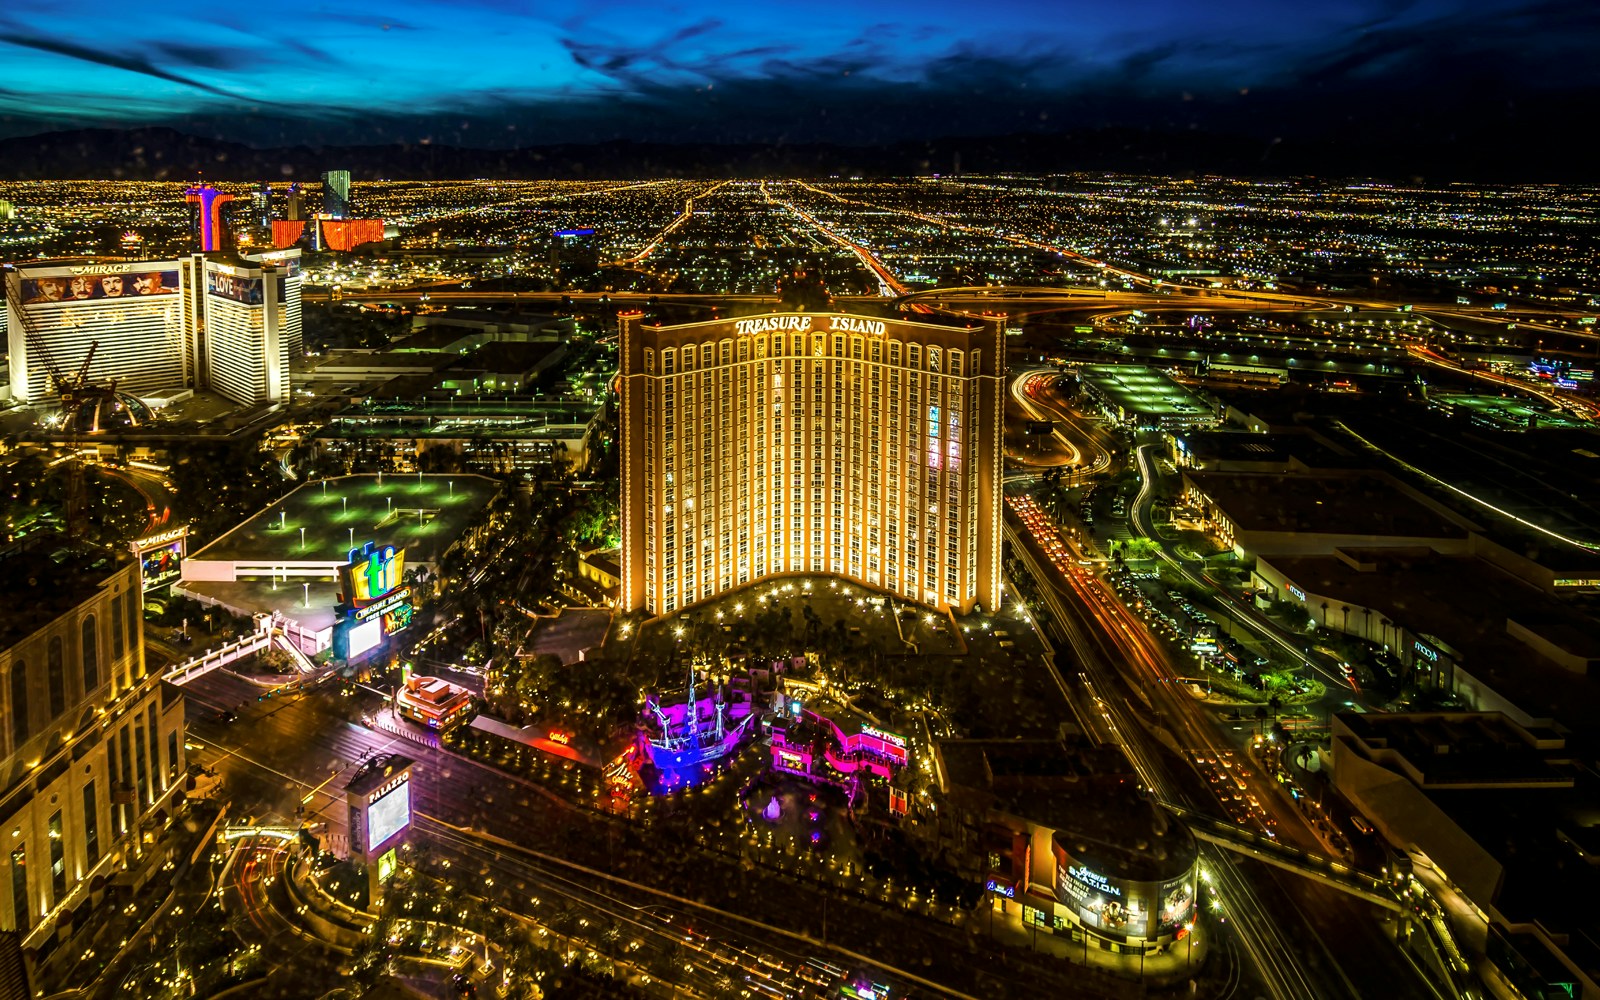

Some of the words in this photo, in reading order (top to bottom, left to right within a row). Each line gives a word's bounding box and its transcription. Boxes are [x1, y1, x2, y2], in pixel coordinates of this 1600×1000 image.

[74, 265, 131, 275] MIRAGE
[215, 275, 234, 295] LOVE
[735, 316, 811, 335] TREASURE
[829, 316, 885, 335] ISLAND
[139, 528, 185, 548] MIRAGE
[360, 600, 386, 617] TREASURE
[368, 771, 409, 804] PALAZZO
